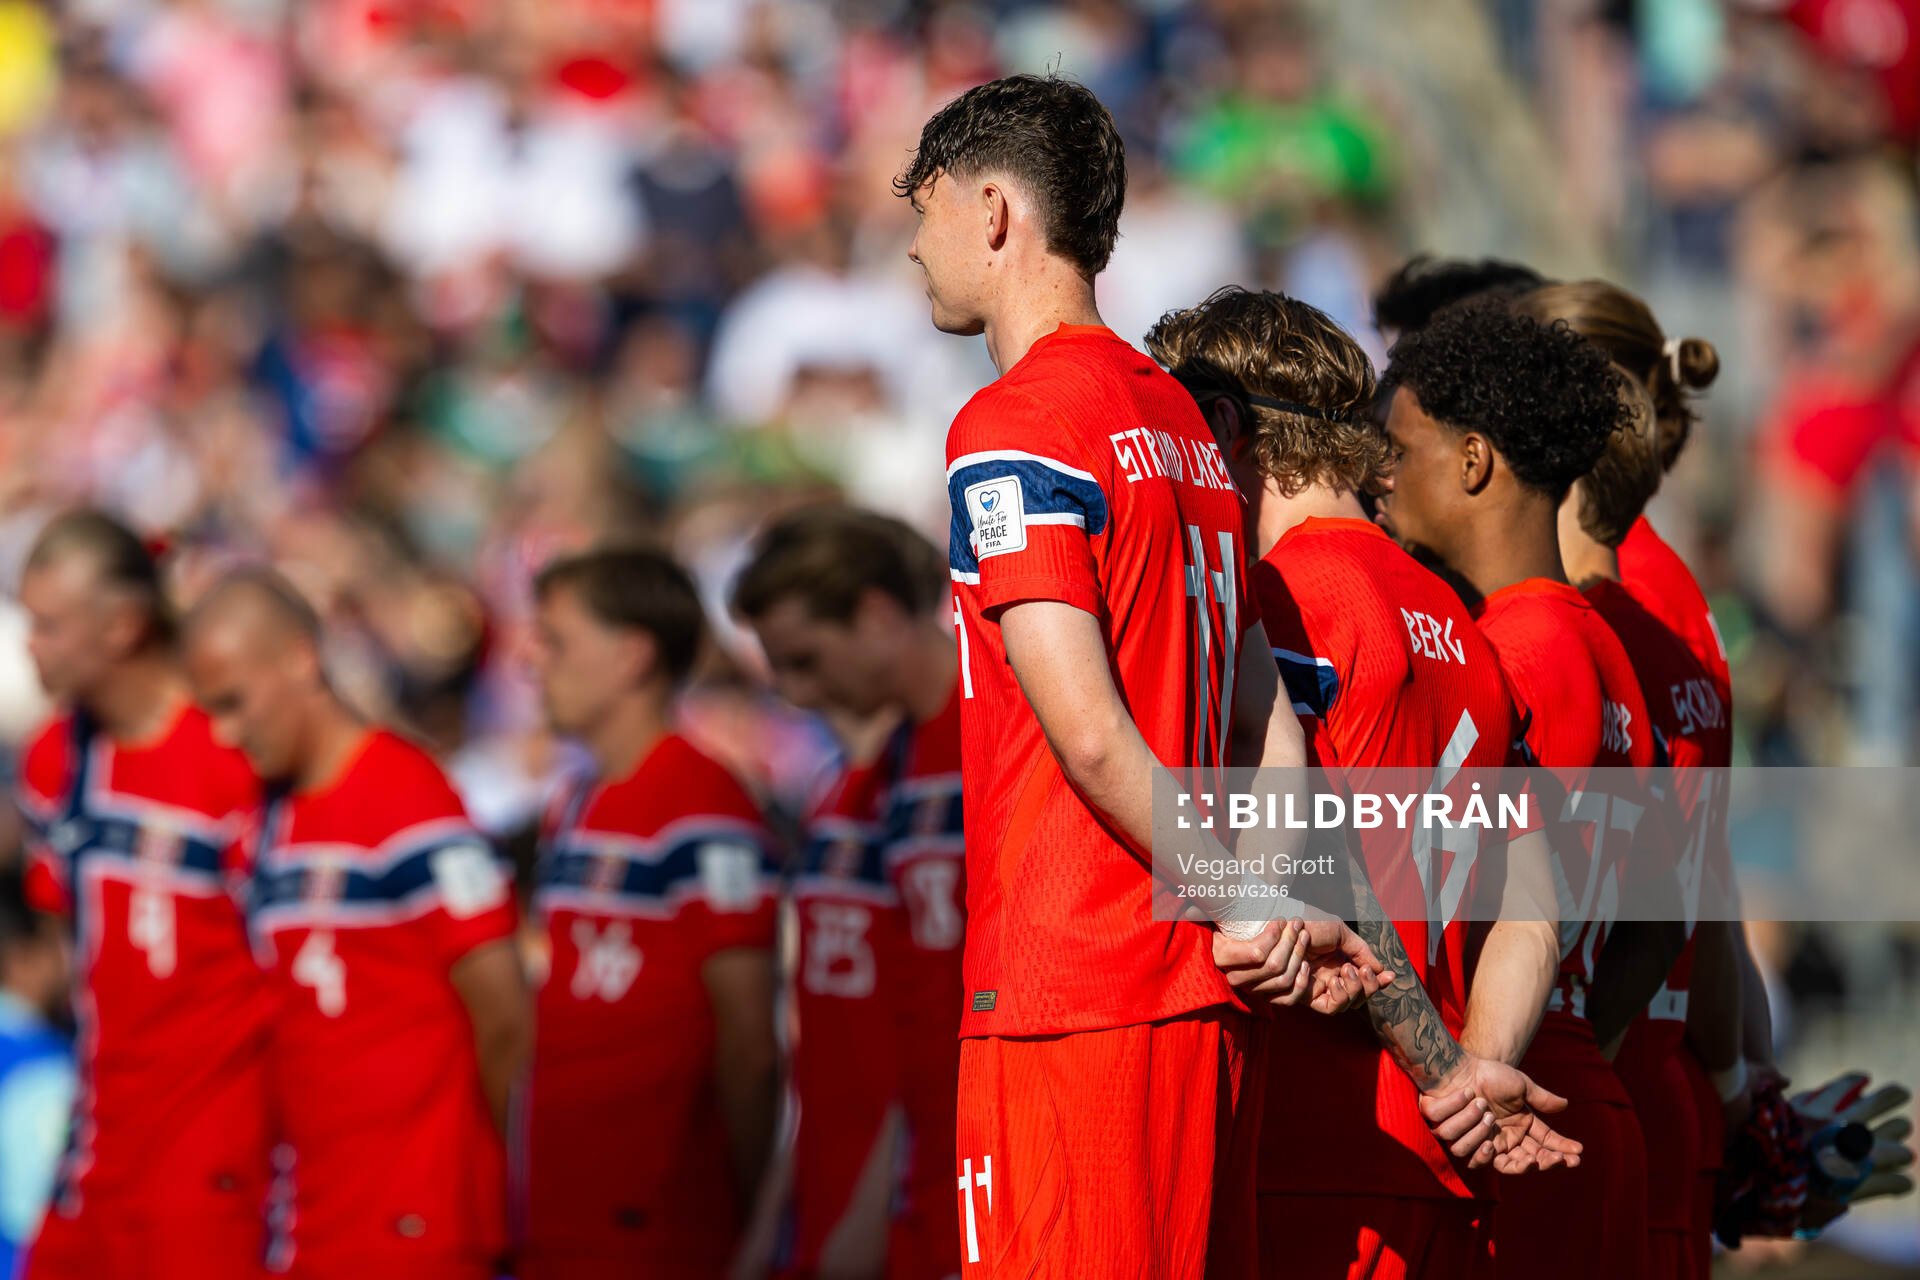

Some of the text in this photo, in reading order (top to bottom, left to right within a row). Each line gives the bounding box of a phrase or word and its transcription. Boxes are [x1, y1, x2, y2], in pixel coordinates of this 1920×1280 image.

[1179, 436, 1240, 495] LARS
[980, 525, 1008, 542] PEACE
[986, 540, 1002, 549] FIFA
[1400, 607, 1466, 665] BERG
[958, 1155, 992, 1263] 11
